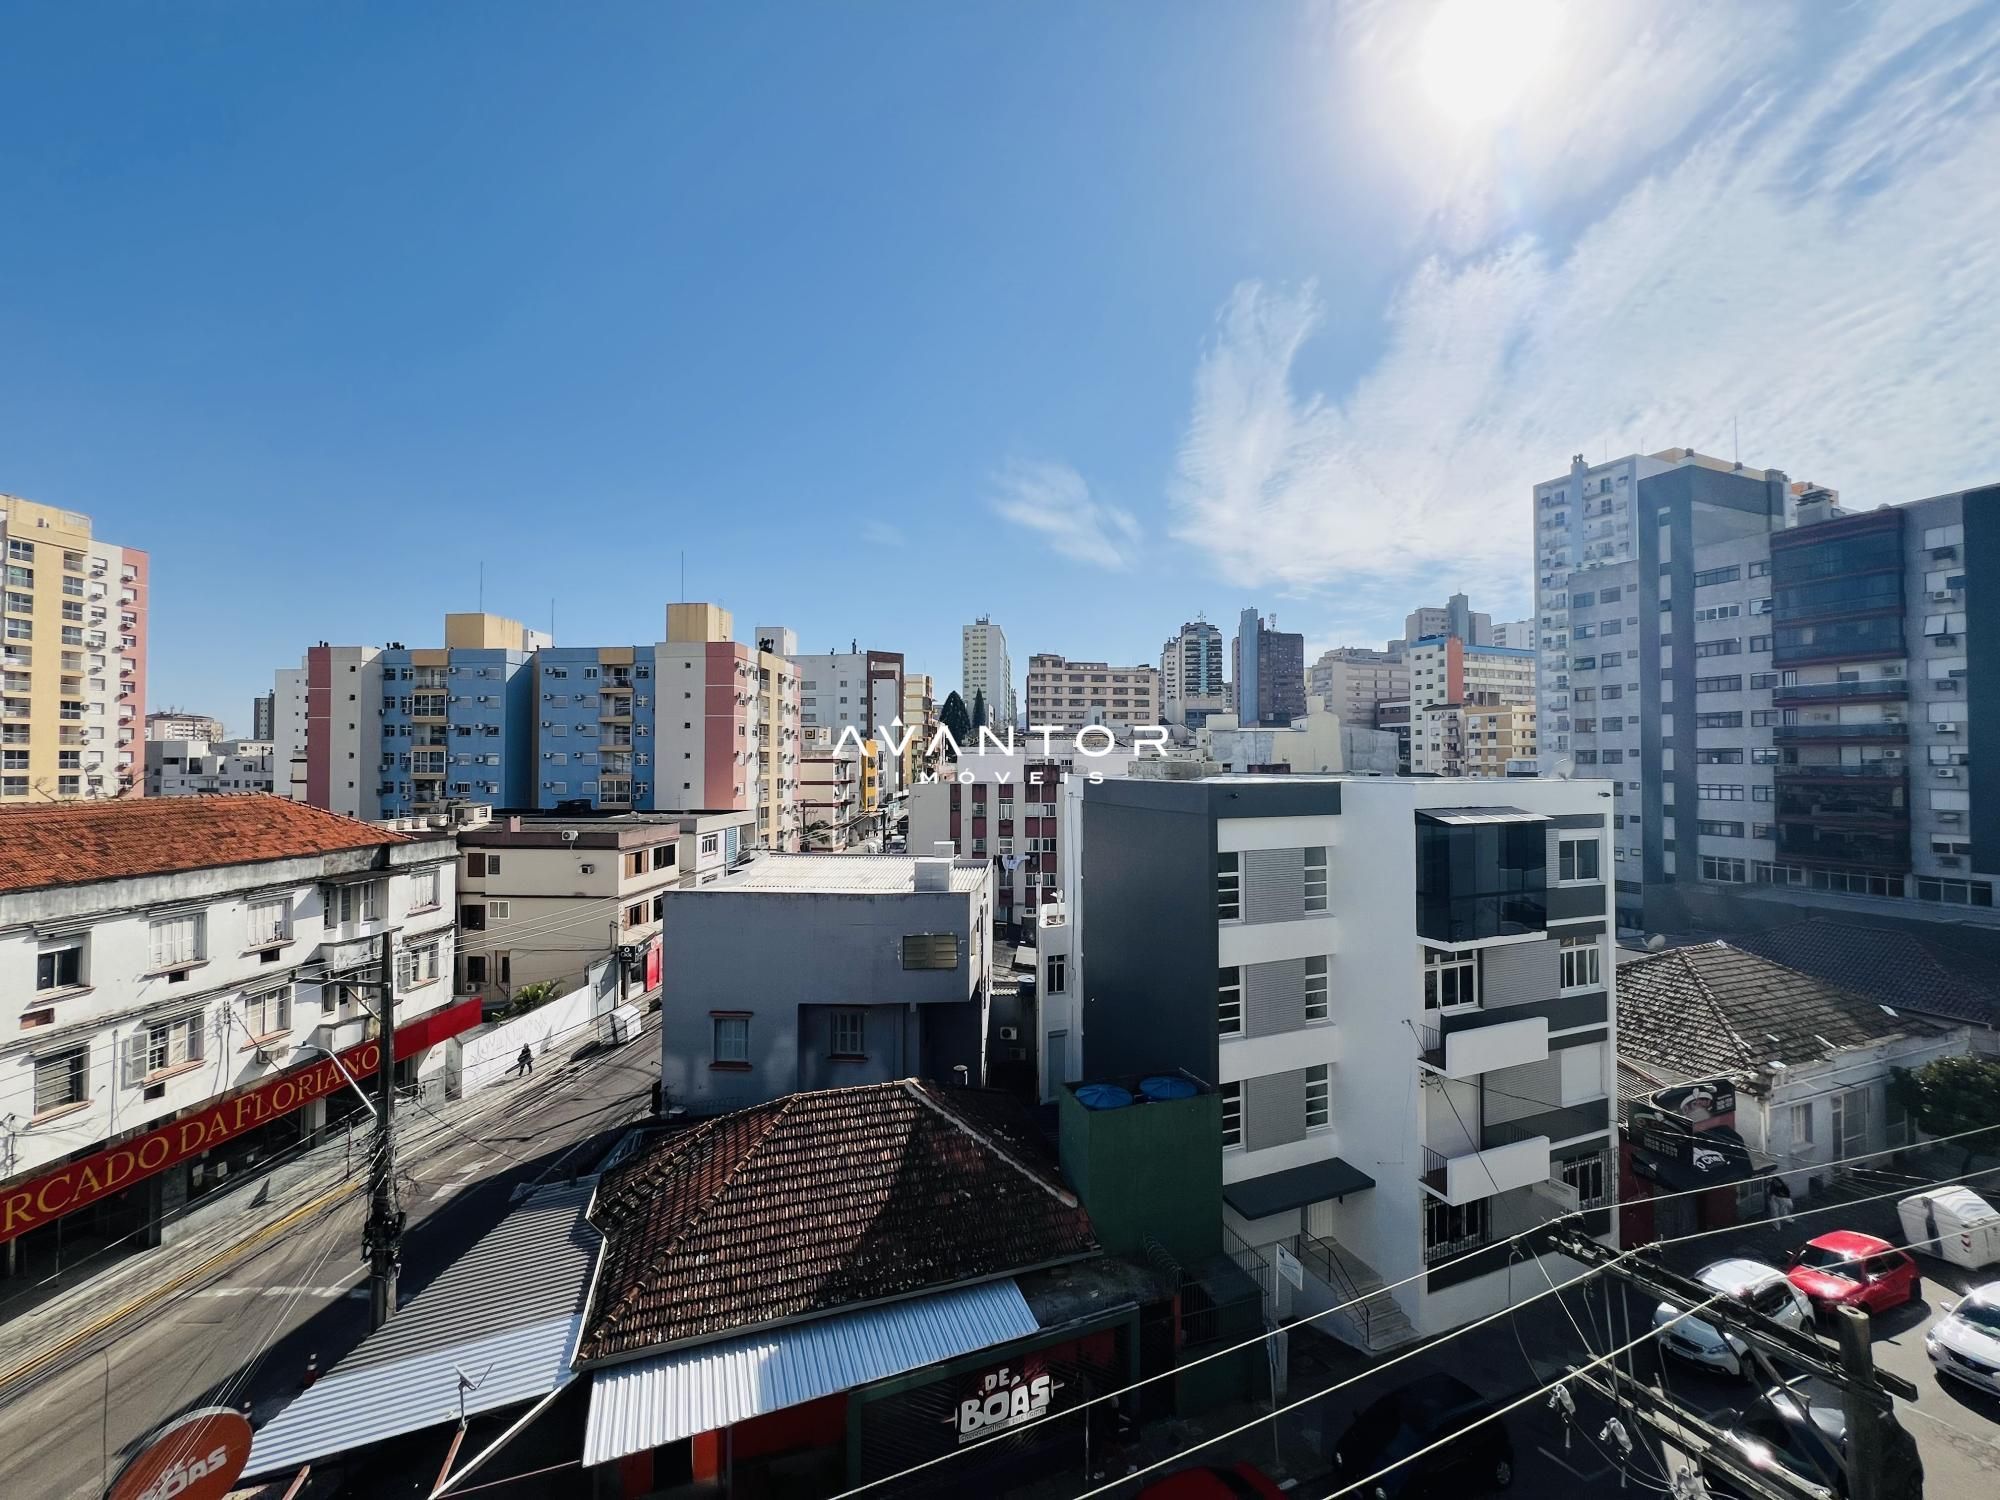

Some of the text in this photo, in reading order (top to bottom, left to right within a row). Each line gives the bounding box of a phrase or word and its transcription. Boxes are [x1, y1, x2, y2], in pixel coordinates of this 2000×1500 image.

[2, 1046, 380, 1233] RCADO DA FLORIANO
[960, 1375, 1050, 1433] BOAS
[984, 1367, 1010, 1391] DE
